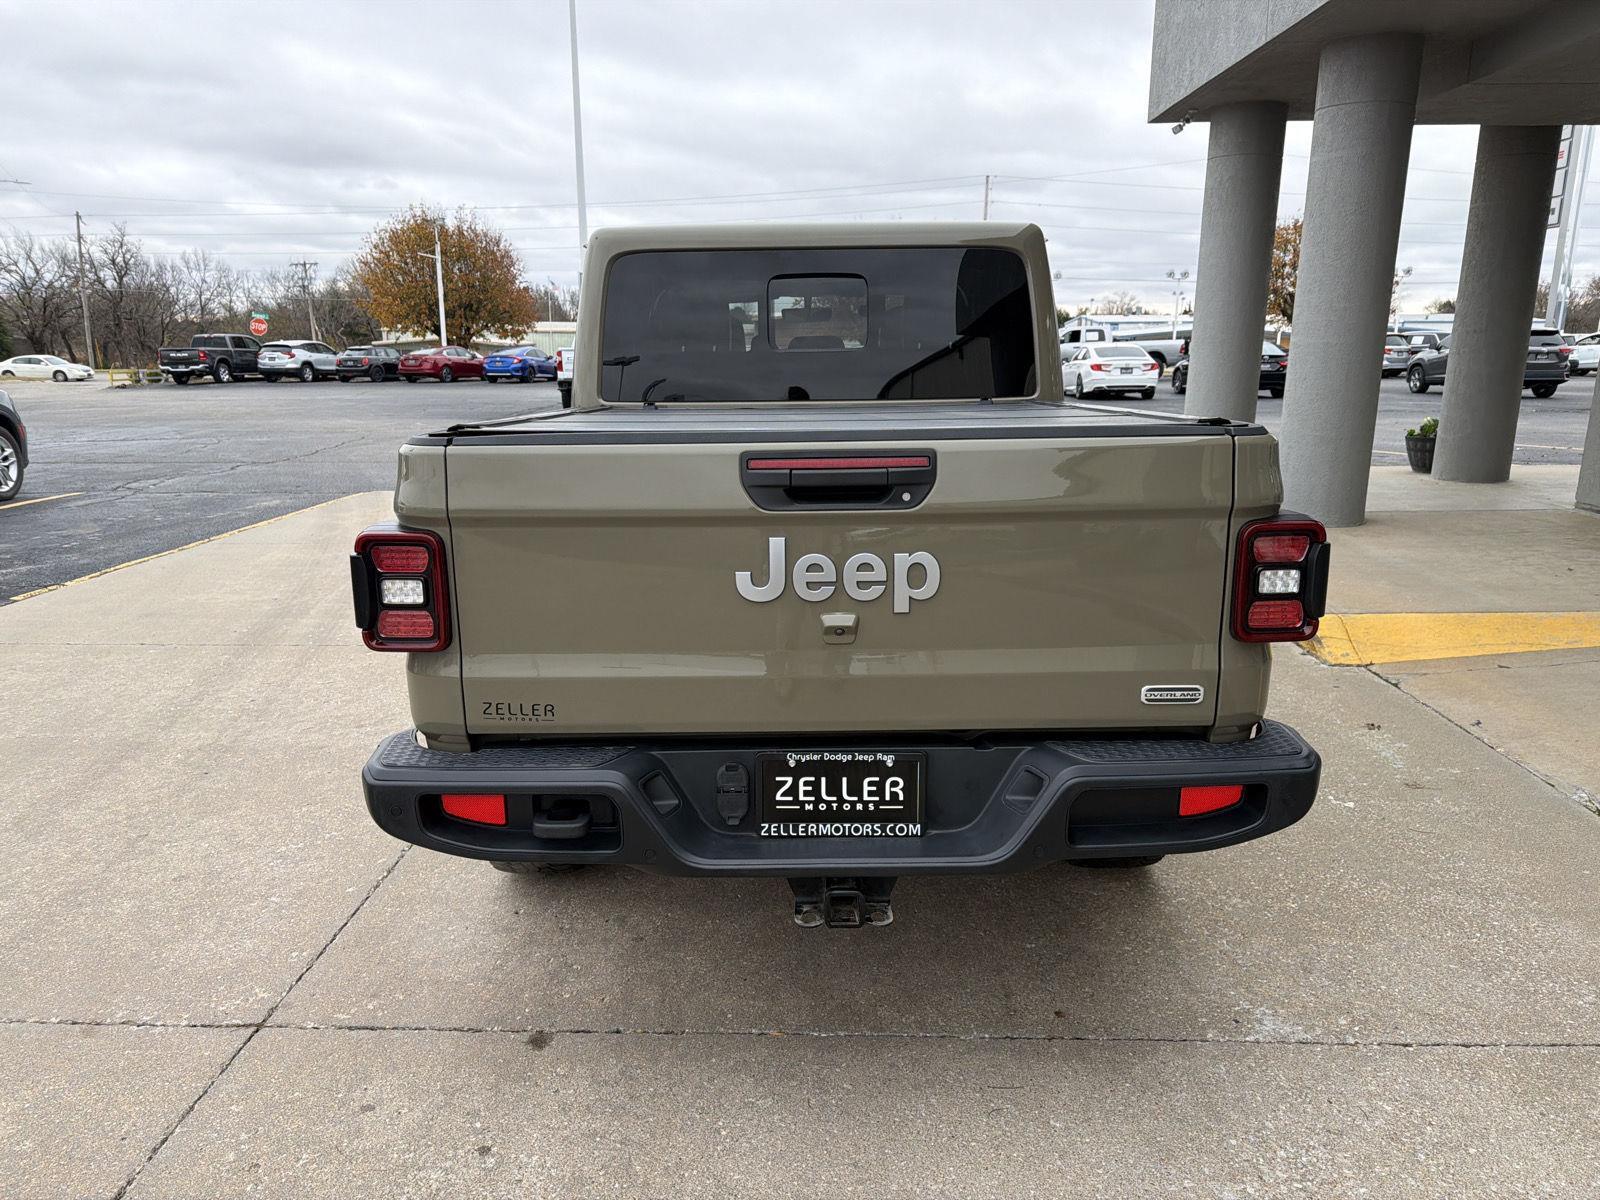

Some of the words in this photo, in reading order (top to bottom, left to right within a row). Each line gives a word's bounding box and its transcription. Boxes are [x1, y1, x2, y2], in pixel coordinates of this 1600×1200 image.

[251, 322, 267, 331] STOP
[735, 537, 941, 614] Jeep
[482, 702, 556, 717] ZELLER
[786, 753, 822, 762] Chrysler
[823, 752, 853, 763] Dodge
[854, 752, 875, 763] Jeep
[876, 752, 895, 761] Ram
[775, 776, 905, 801] ZELLER
[804, 803, 876, 811] MOTORS
[760, 823, 922, 836] ZELLERMOTORS.COM
